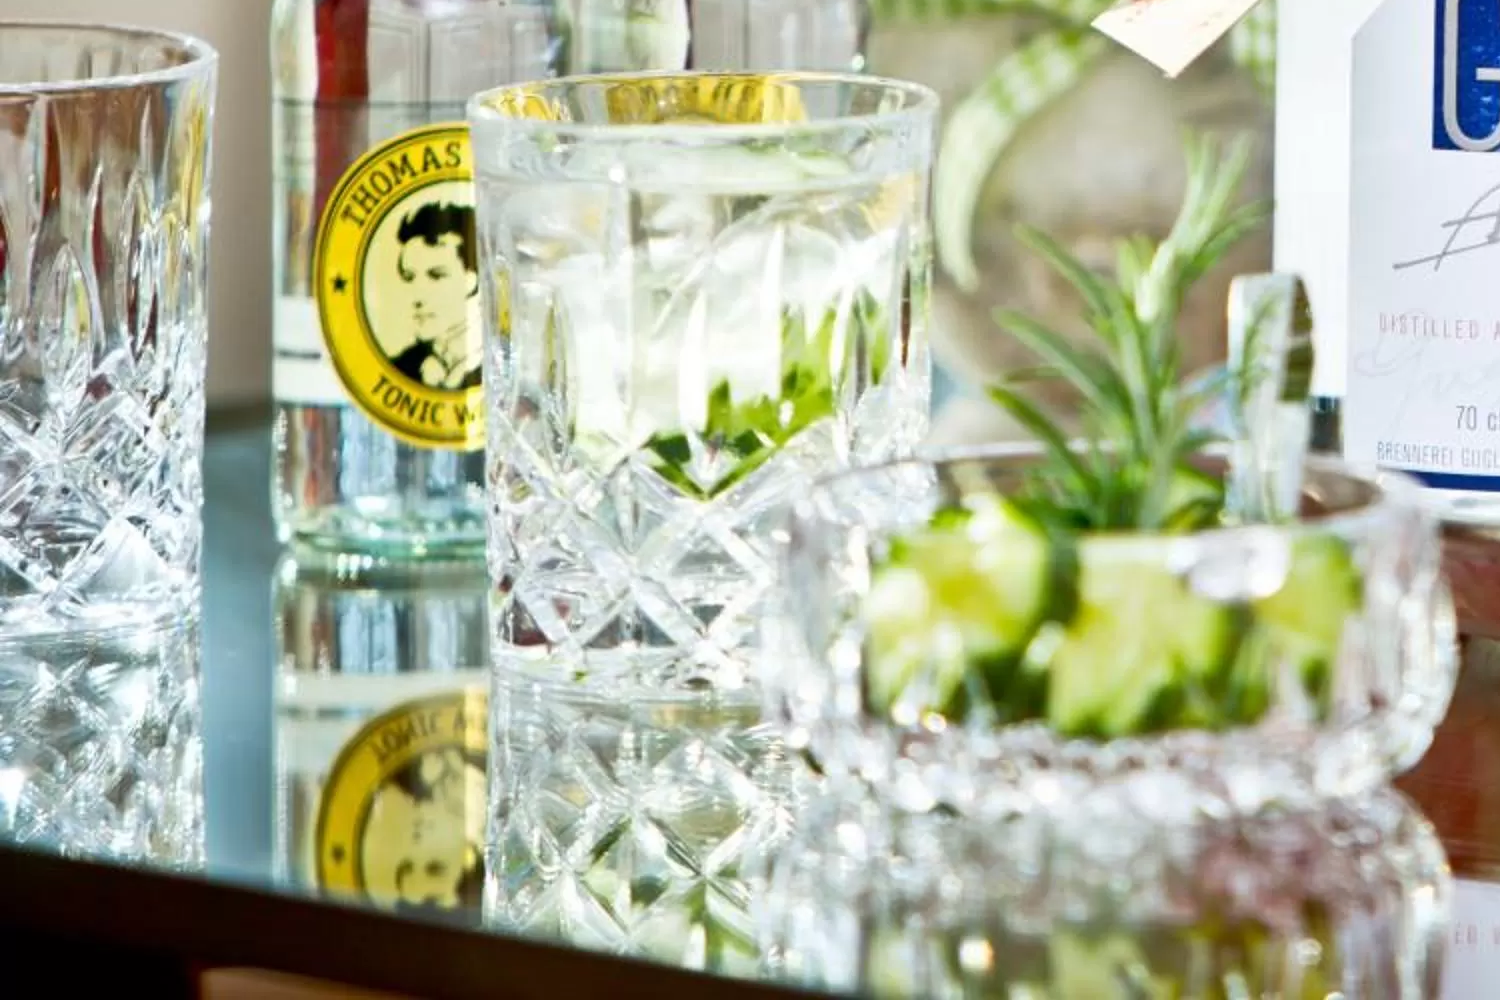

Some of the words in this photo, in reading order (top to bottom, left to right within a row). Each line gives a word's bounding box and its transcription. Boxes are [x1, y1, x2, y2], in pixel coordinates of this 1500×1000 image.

[340, 141, 462, 228] THOMAS
[1378, 311, 1480, 341] DISTILLED
[371, 374, 445, 428] TONIC
[1455, 404, 1478, 432] 70
[1376, 440, 1454, 468] BRENNEREI
